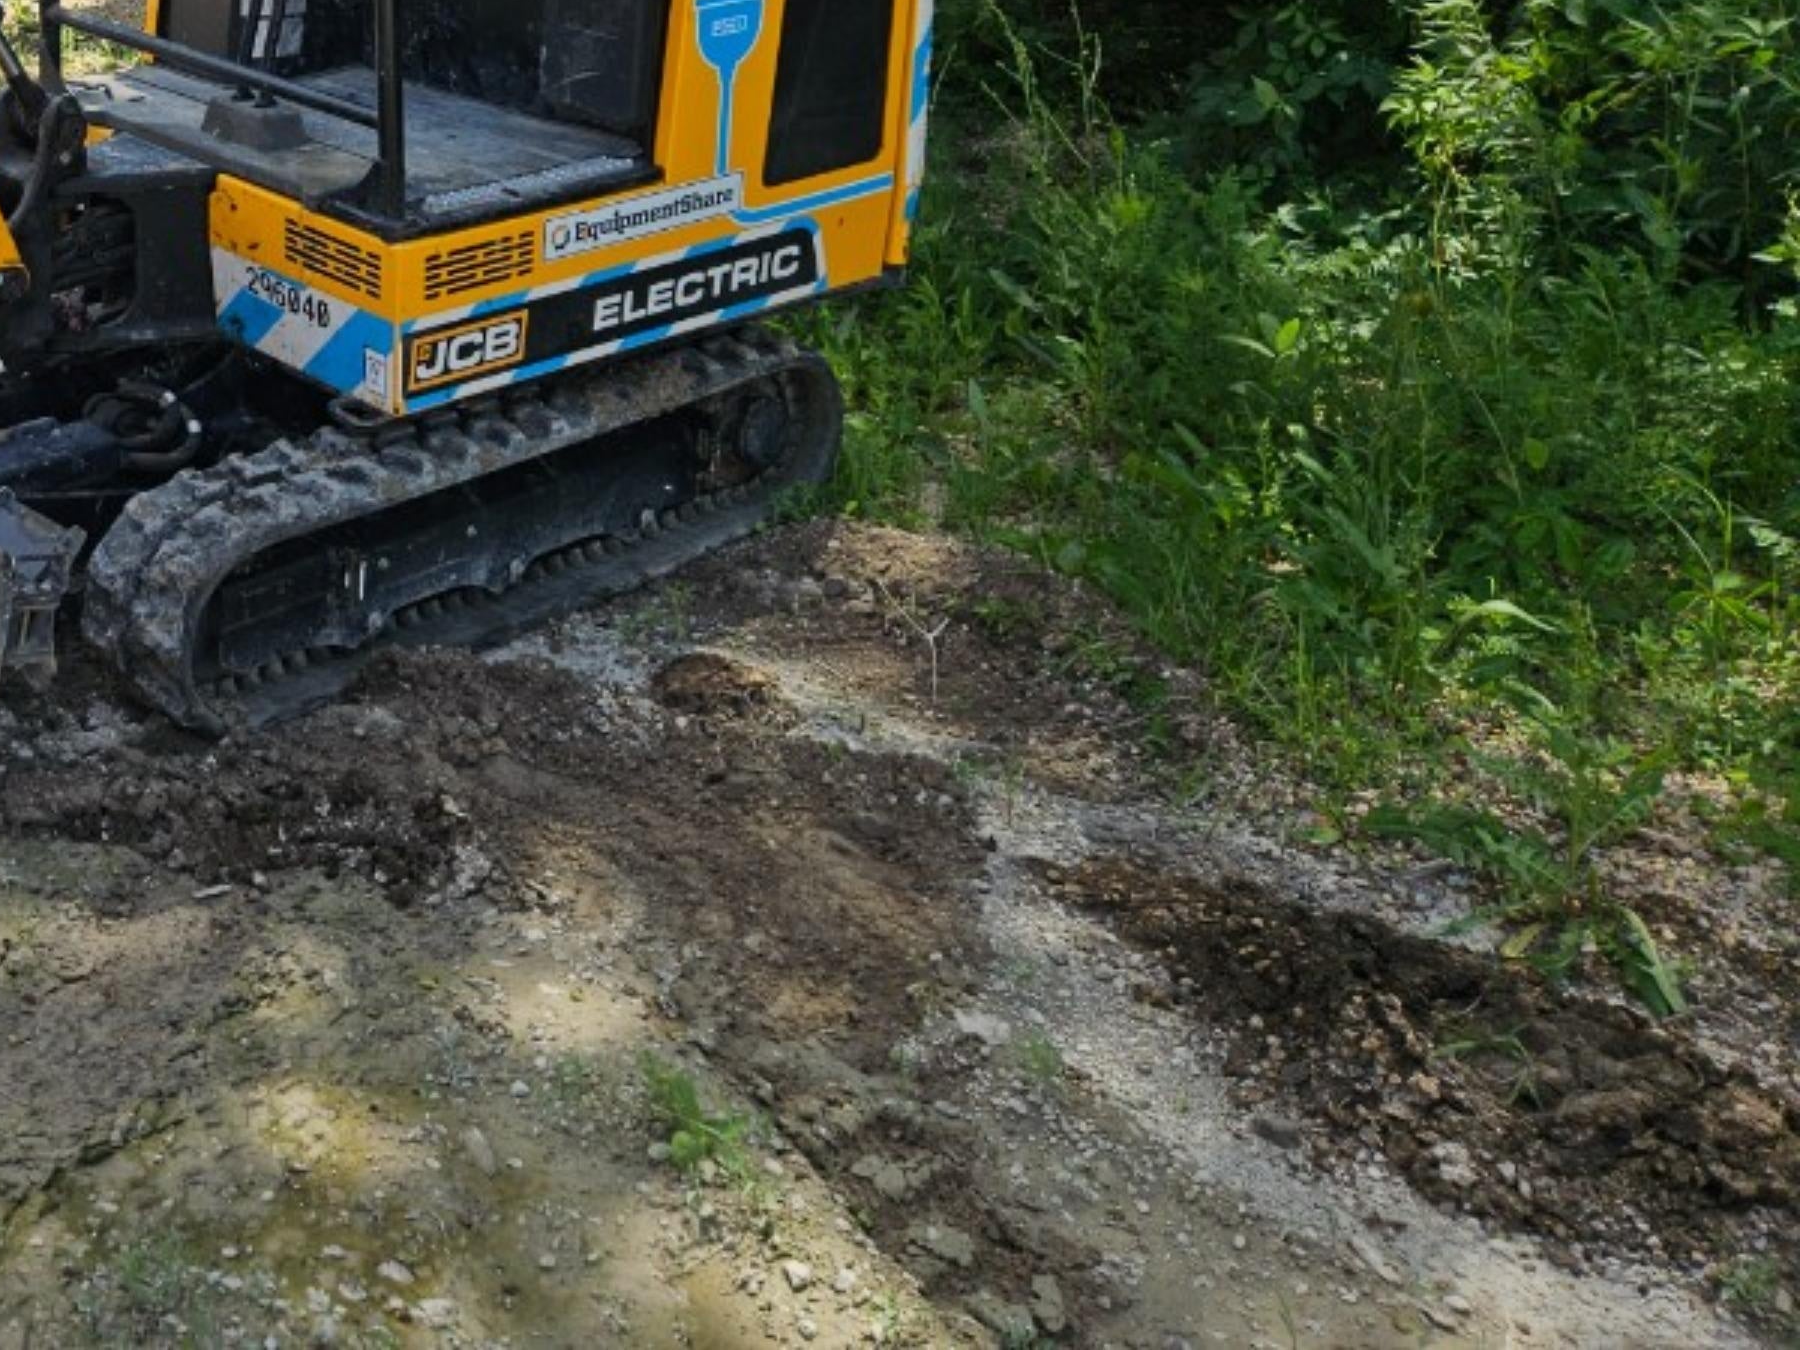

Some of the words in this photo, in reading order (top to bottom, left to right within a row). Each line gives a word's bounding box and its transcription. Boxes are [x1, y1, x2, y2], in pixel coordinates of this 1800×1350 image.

[574, 188, 734, 241] EquipmentShare
[246, 266, 331, 327] 296040
[593, 244, 801, 332] ELECTRIC
[415, 322, 521, 381] JCB
